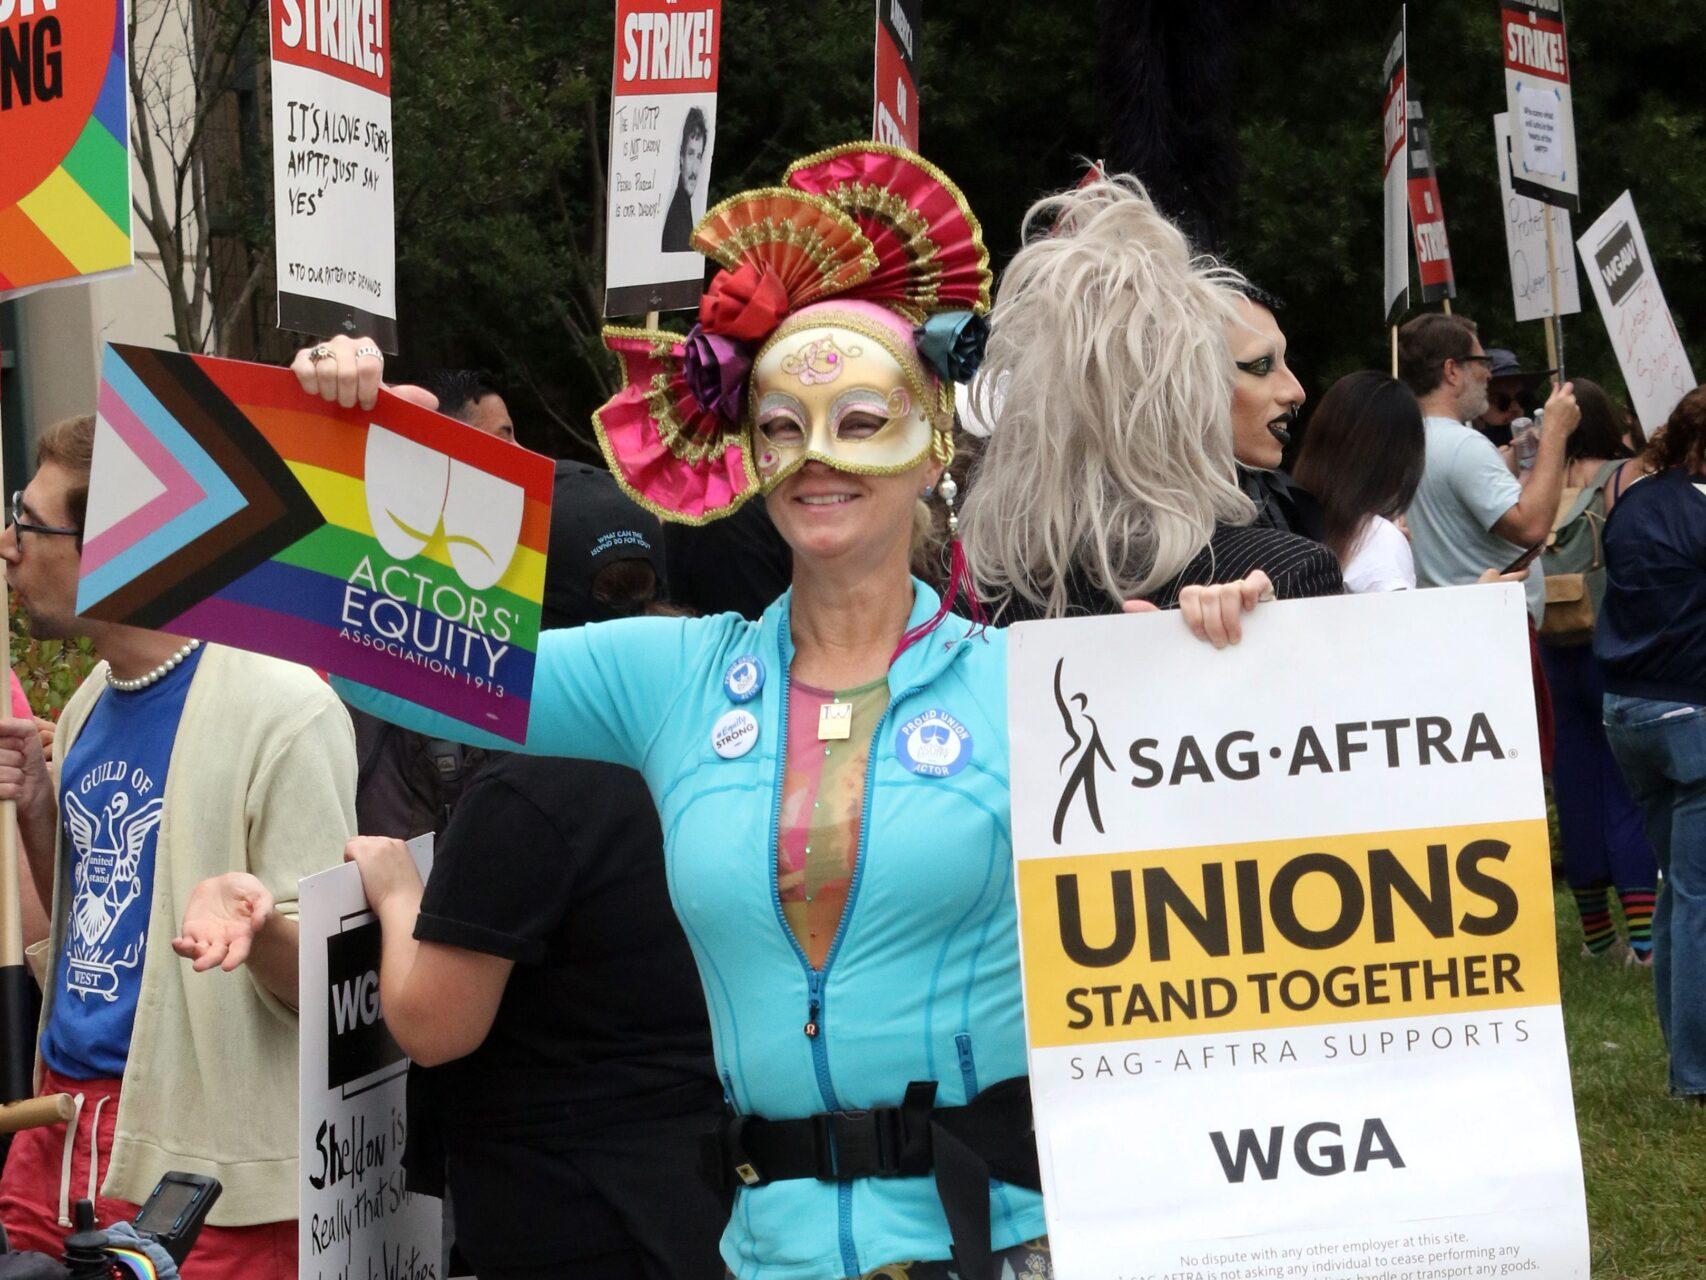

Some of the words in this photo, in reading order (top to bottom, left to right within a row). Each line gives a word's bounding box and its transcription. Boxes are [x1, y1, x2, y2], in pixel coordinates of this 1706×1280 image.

[281, 0, 384, 78] STRIKE!
[623, 9, 713, 81] STRIKE!
[1507, 22, 1565, 75] STRIKE!
[287, 101, 320, 144] IT'S
[323, 110, 330, 144] A
[332, 112, 360, 144] LOVE
[332, 158, 359, 184] JUST
[363, 167, 379, 191] SAY
[308, 267, 323, 284] OUR
[1601, 239, 1637, 286] WGAW
[348, 555, 519, 642] ACTORS'
[341, 585, 509, 678] EQUITY
[339, 628, 456, 680] ASSOCIATION
[466, 672, 505, 698] 1913
[716, 723, 754, 749] STRONG
[902, 709, 937, 735] PROUD
[941, 711, 970, 740] UNION
[81, 761, 127, 794] GUILD
[131, 768, 153, 796] OF
[914, 763, 949, 776] ACTOR
[89, 855, 113, 867] united
[89, 874, 109, 884] stand
[94, 866, 106, 874] we
[1055, 839, 1519, 969] UNIONS
[331, 970, 383, 1035] WG
[1065, 976, 1237, 1030] STAND
[1247, 952, 1524, 1014] TOGETHER
[1071, 1038, 1298, 1081] SAG-AFTRA
[1324, 1019, 1530, 1060] SUPPORTS
[1209, 1117, 1406, 1184] WGA
[311, 1199, 352, 1265] Really
[354, 1176, 387, 1229] that
[1180, 1255, 1199, 1267] No
[1202, 1251, 1247, 1267] dispute
[1250, 1249, 1278, 1261] with
[1281, 1248, 1302, 1261] any
[1306, 1243, 1338, 1256] other
[1343, 1237, 1398, 1255] employer
[1403, 1237, 1415, 1248] at
[1418, 1233, 1441, 1246] this
[1443, 1231, 1469, 1244] site.
[1220, 1268, 1241, 1280] not
[1244, 1263, 1284, 1279] asking
[1287, 1262, 1309, 1277] any
[1312, 1256, 1371, 1273] individual
[1375, 1254, 1388, 1267] to
[1391, 1253, 1425, 1265] cease
[1428, 1246, 1496, 1264] performing
[1499, 1245, 1520, 1257] any
[1417, 1265, 1472, 1280] transport
[1476, 1262, 1497, 1276] any
[1500, 1258, 1540, 1277] goods.
